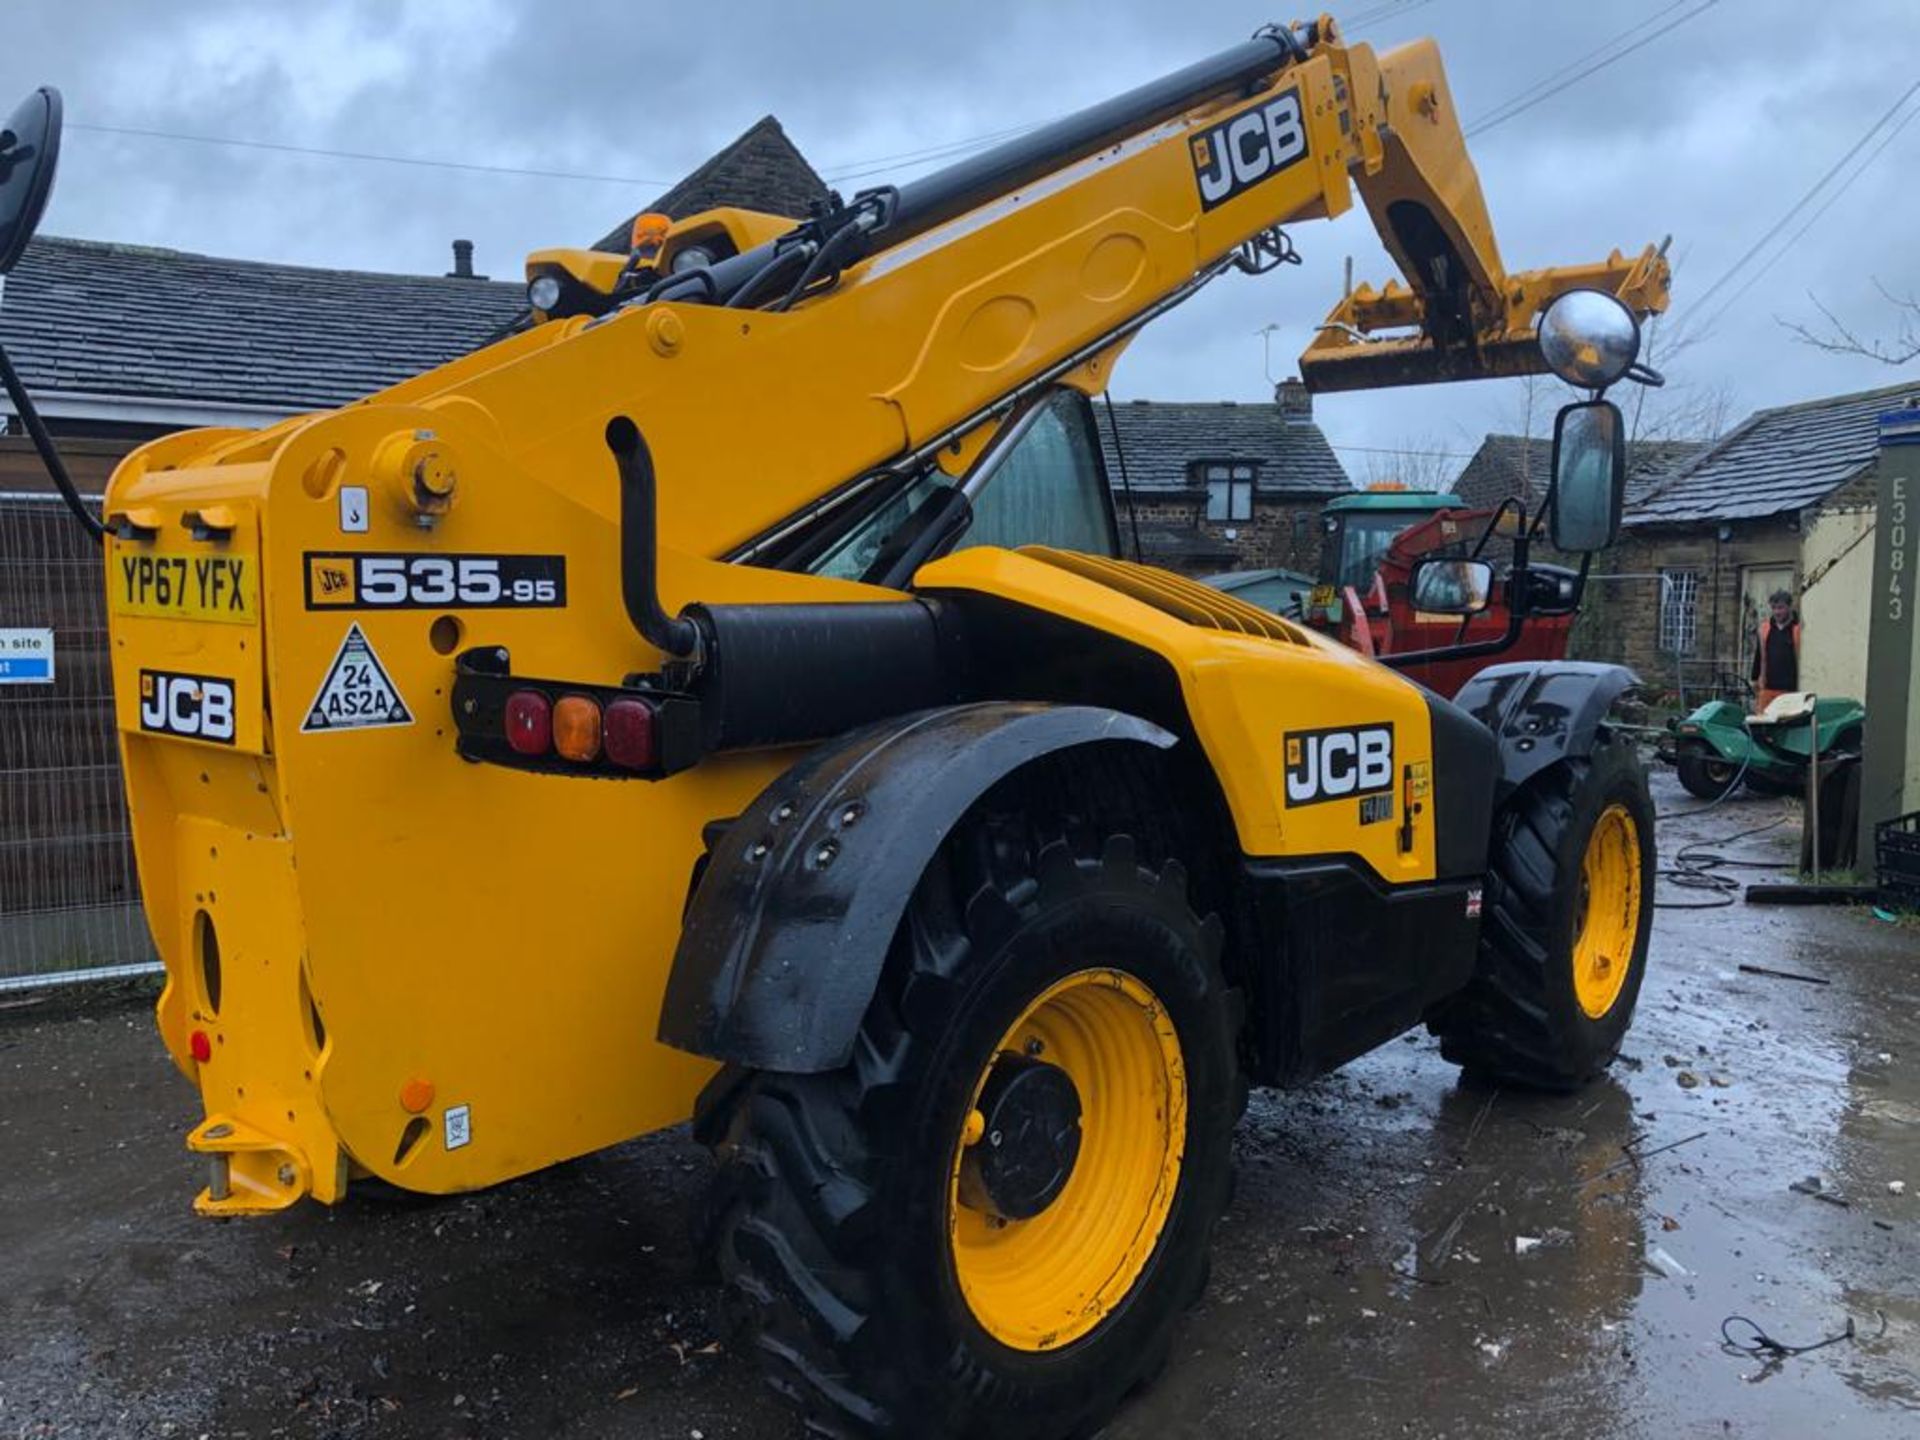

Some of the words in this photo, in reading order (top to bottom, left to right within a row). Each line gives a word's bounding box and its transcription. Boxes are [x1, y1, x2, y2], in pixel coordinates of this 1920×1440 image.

[1200, 95, 1305, 201] JCB
[122, 556, 187, 607] YP67
[195, 558, 245, 611] YFX
[361, 557, 556, 603] 535-95
[12, 637, 42, 650] site
[343, 664, 372, 689] 24
[142, 676, 233, 739] JCB
[328, 690, 388, 716] AS2A
[1287, 729, 1392, 801] JCB
